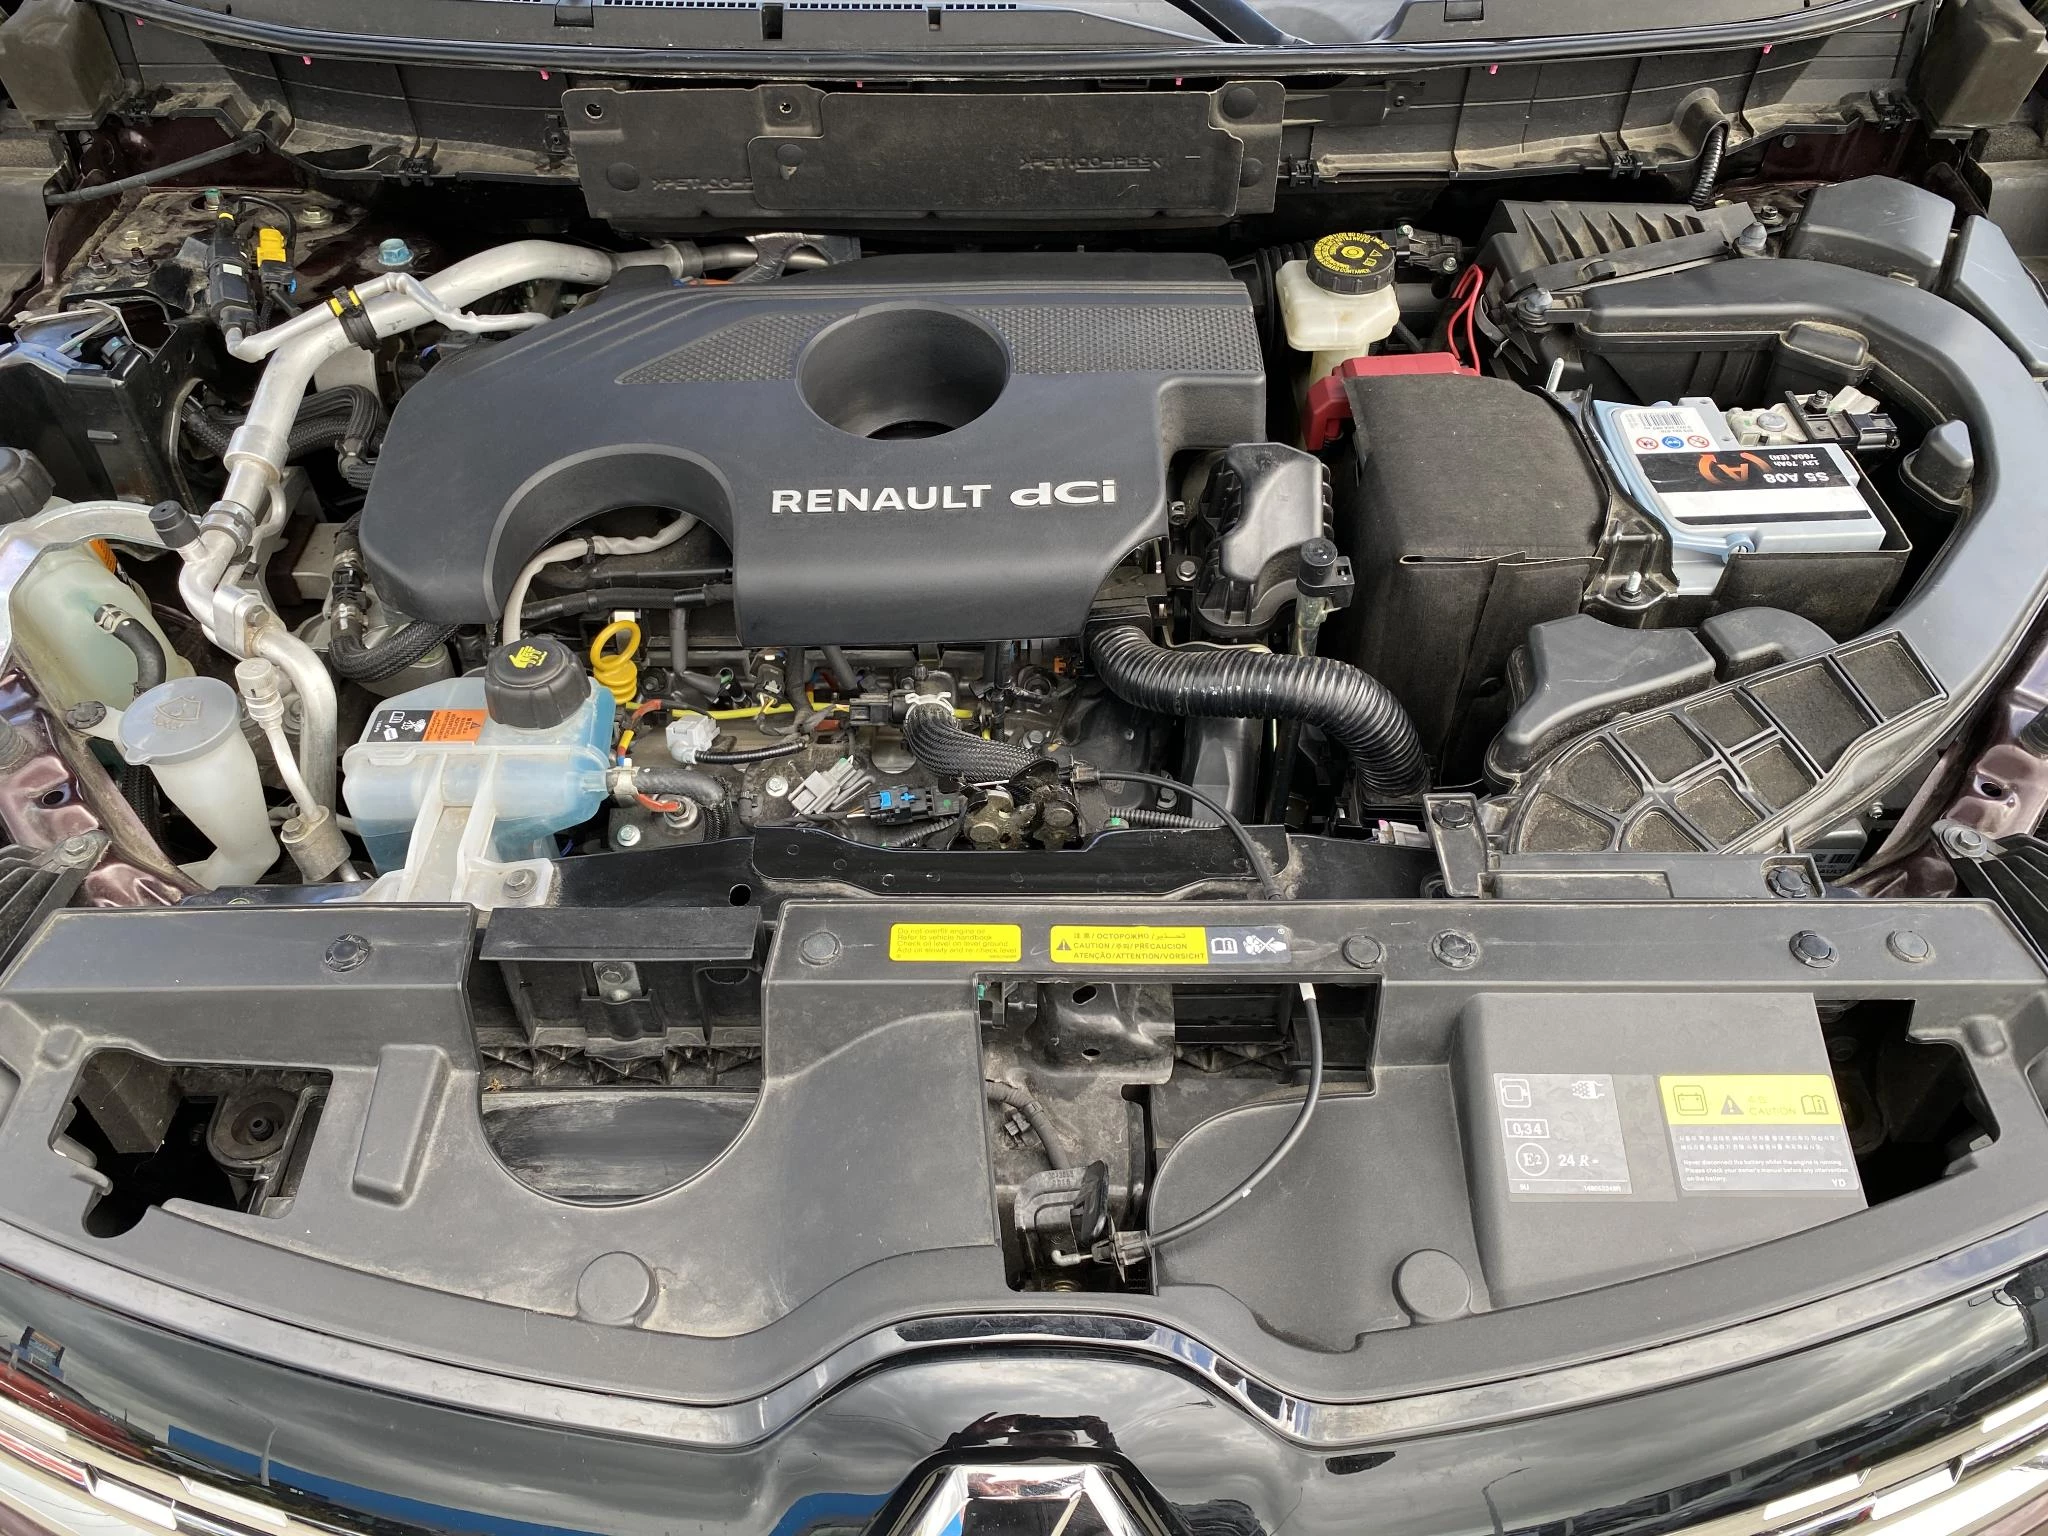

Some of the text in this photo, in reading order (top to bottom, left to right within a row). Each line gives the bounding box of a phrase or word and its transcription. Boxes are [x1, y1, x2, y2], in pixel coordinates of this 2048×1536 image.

[1763, 472, 1830, 482] S5 A08
[771, 479, 1116, 514] RENAULT dCi
[1749, 1106, 1797, 1116] CAUTION
[1512, 1123, 1542, 1136] 0,34
[1558, 1154, 1576, 1167] 24
